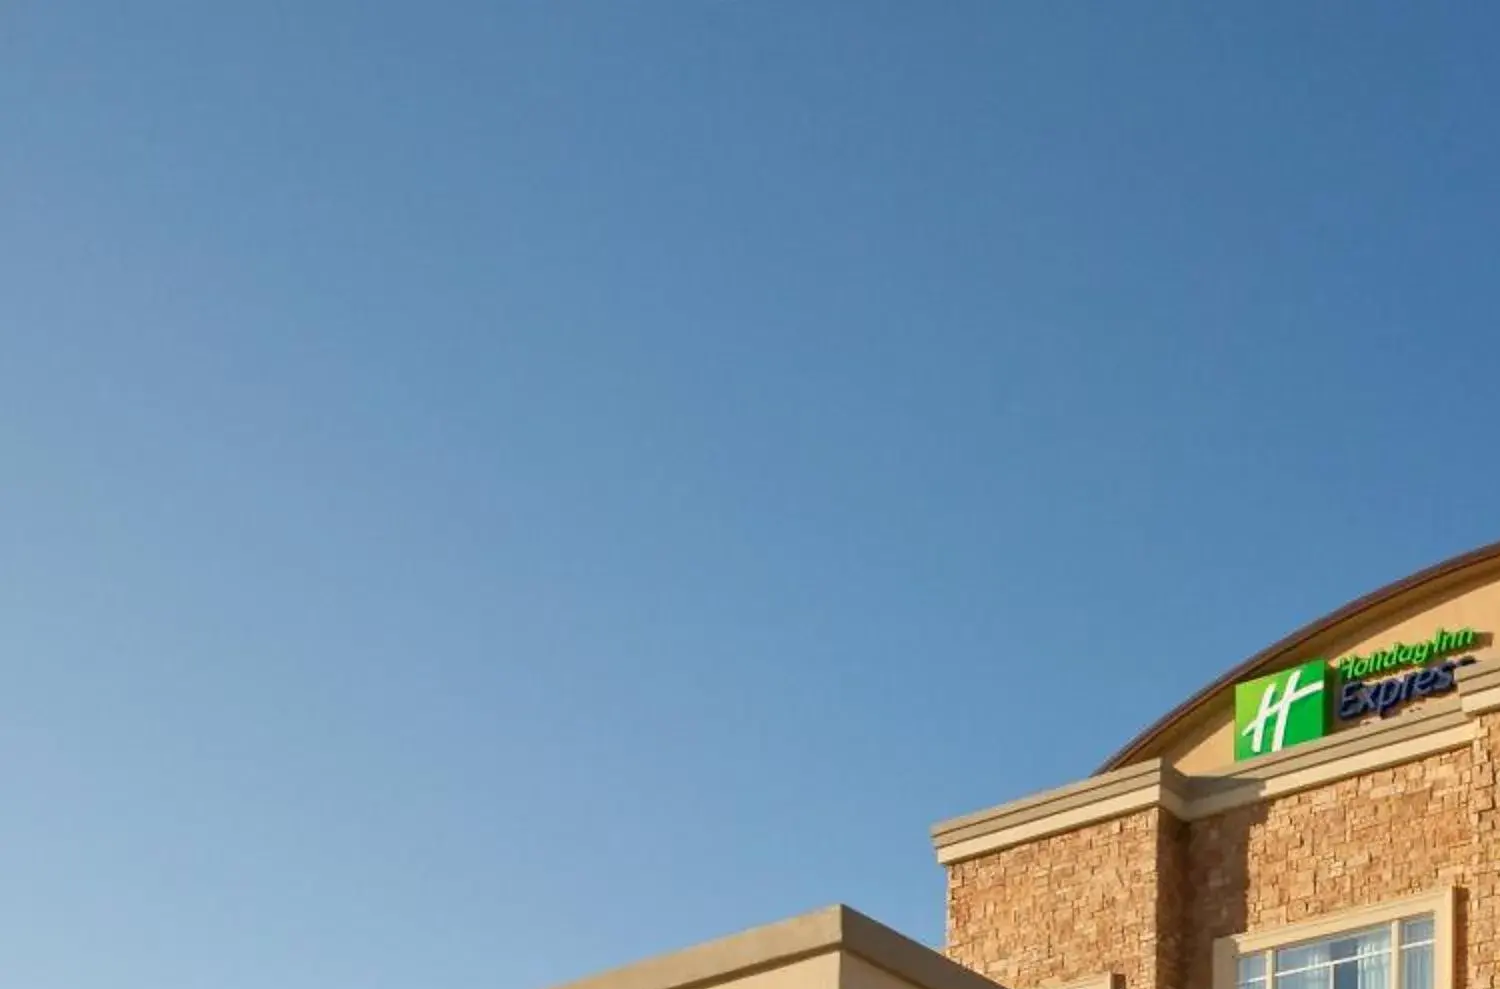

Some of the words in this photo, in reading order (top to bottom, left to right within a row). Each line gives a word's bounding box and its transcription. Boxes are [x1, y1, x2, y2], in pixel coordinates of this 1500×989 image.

[1338, 641, 1431, 679] Holiday
[1434, 627, 1475, 653] Inn
[1340, 655, 1476, 719] Expres
